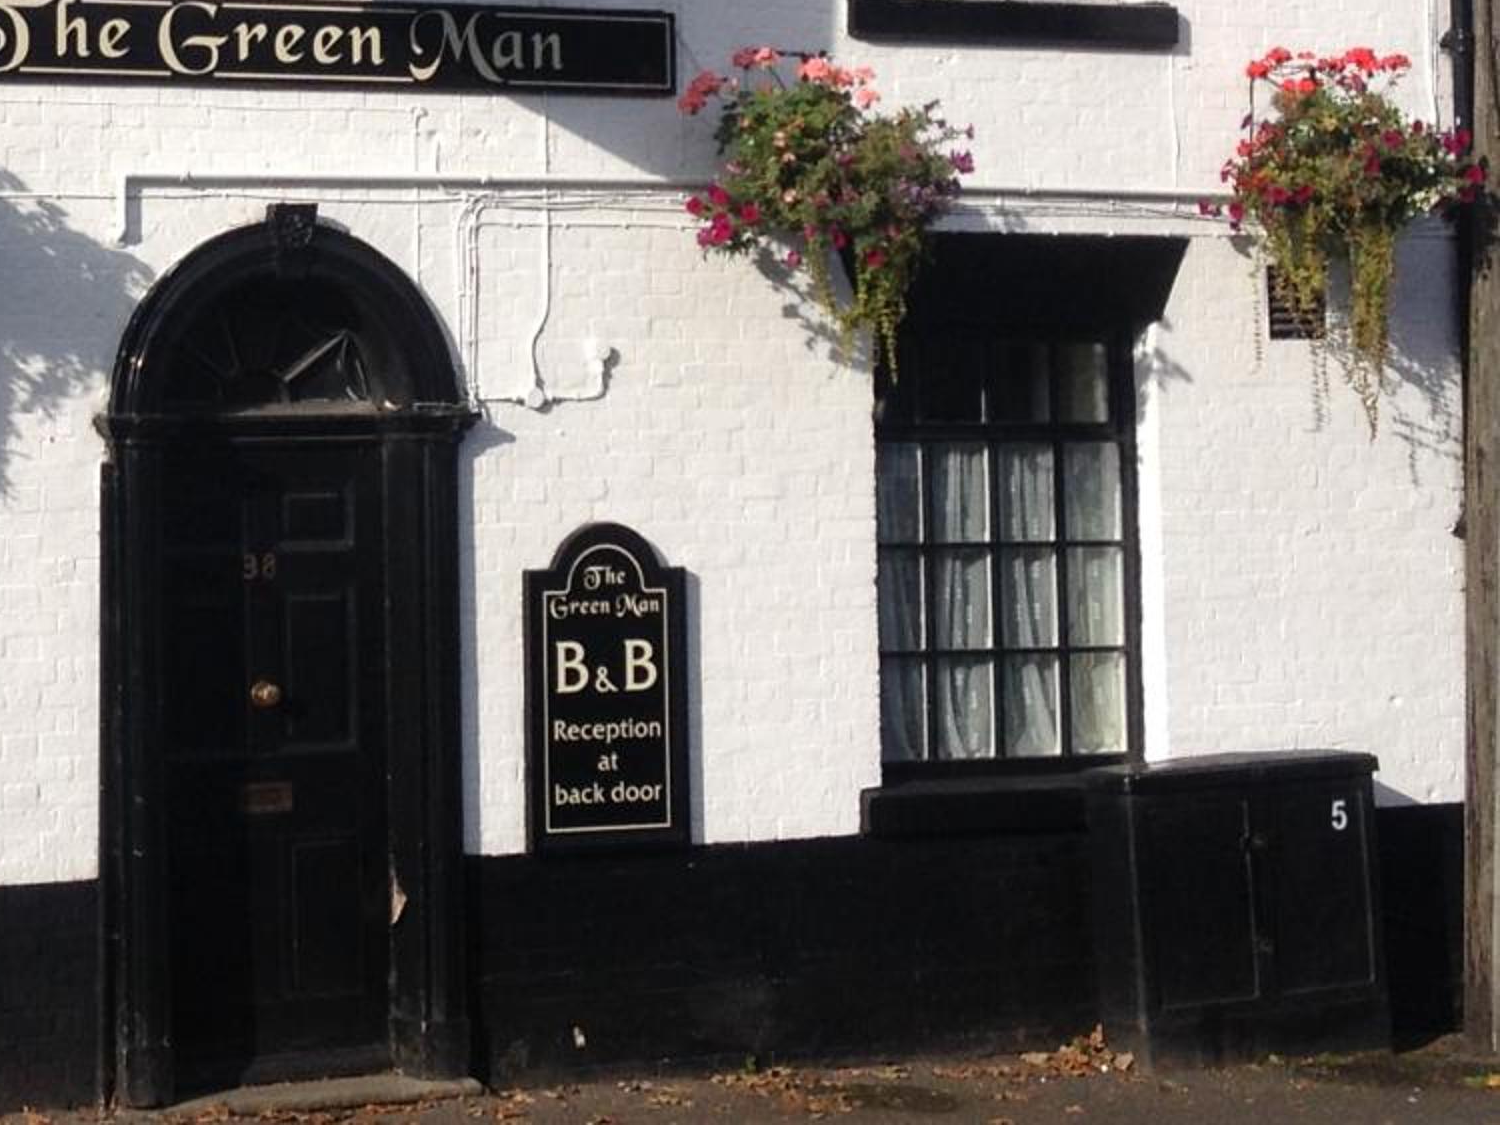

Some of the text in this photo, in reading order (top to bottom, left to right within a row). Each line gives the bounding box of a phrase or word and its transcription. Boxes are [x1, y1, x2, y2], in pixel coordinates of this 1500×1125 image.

[157, 1, 386, 75] Green
[409, 9, 564, 81] Man
[583, 565, 626, 590] The
[550, 594, 660, 619] Green Man
[553, 718, 661, 744] Reception
[597, 754, 618, 772] at
[555, 781, 662, 806] back door
[1330, 799, 1348, 831] 5
